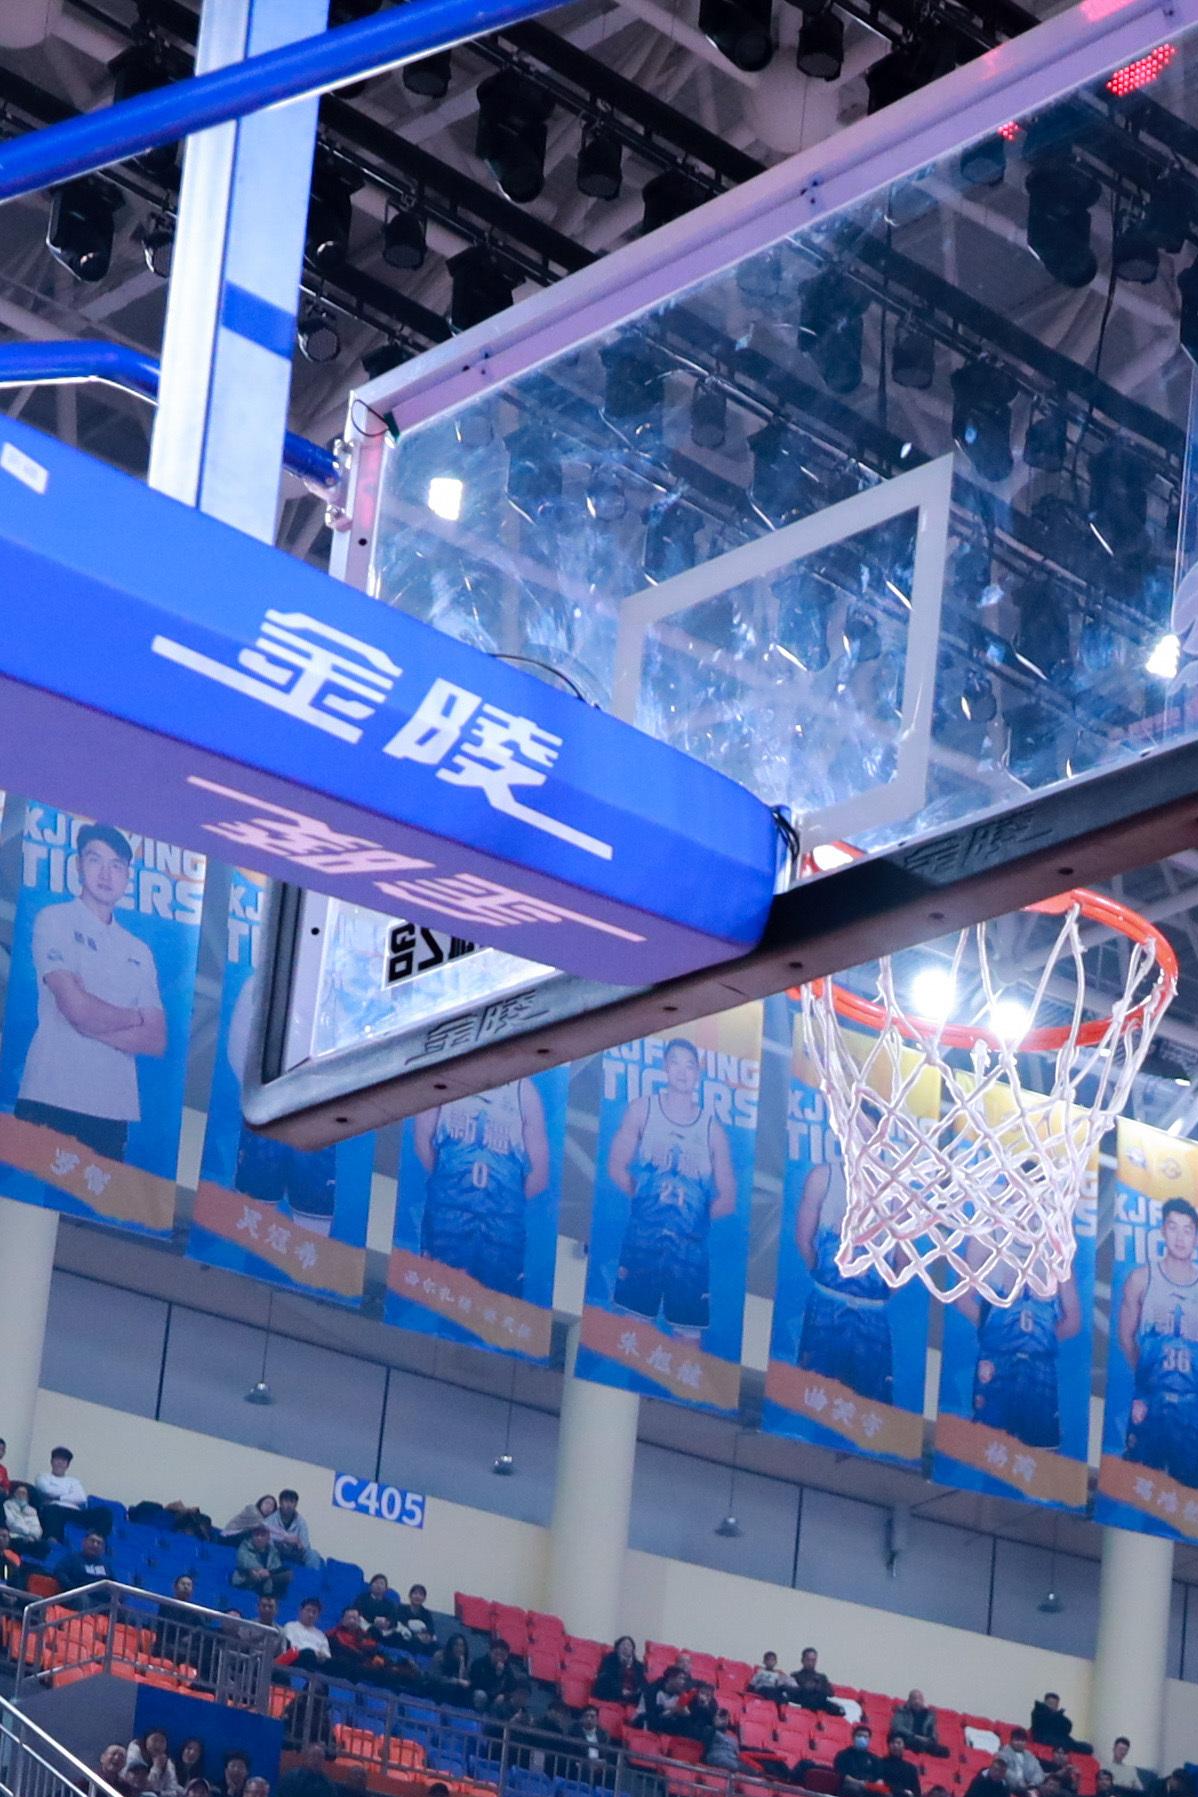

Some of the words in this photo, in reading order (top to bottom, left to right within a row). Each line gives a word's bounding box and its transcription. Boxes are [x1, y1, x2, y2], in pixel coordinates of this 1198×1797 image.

[150, 608, 613, 862] 金陵
[471, 1161, 488, 1189] 0
[334, 1474, 423, 1527] C405
